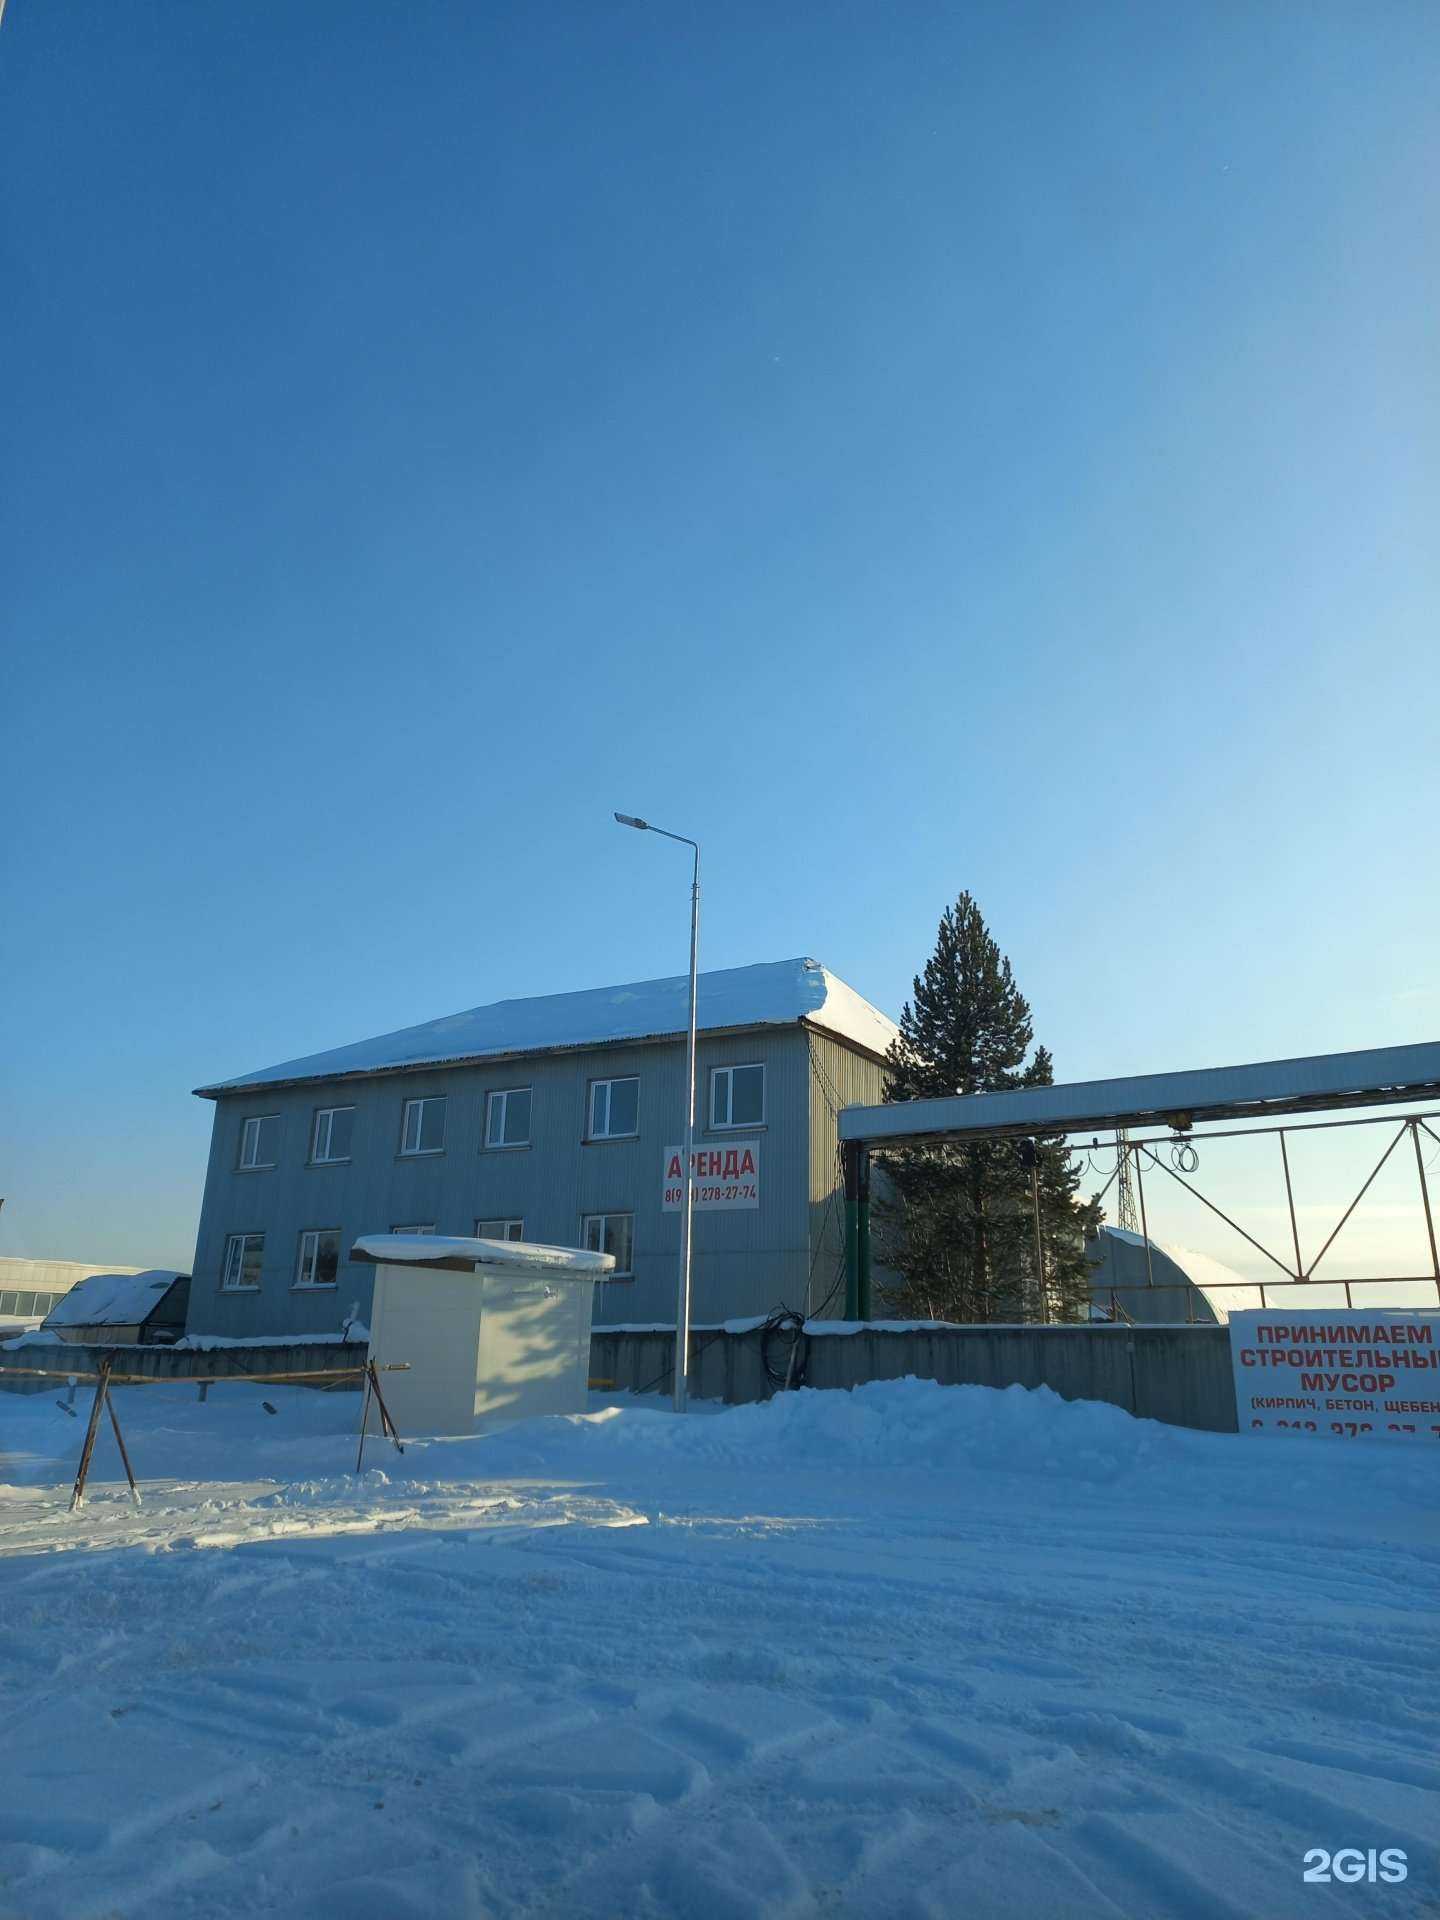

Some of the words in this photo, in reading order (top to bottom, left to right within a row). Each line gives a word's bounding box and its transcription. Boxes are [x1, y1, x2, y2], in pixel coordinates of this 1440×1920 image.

[665, 1187, 699, 1203] 8(9)
[702, 1185, 756, 1201] 278-27-74
[1257, 1325, 1433, 1344] ПРИНИМАЕМ
[1240, 1349, 1440, 1368] СТРОИТЕЛЬНЫ
[1301, 1373, 1396, 1393] МУСОР
[1251, 1397, 1321, 1411] (КИРПИЧ,
[1325, 1399, 1379, 1413] БЕТОН,
